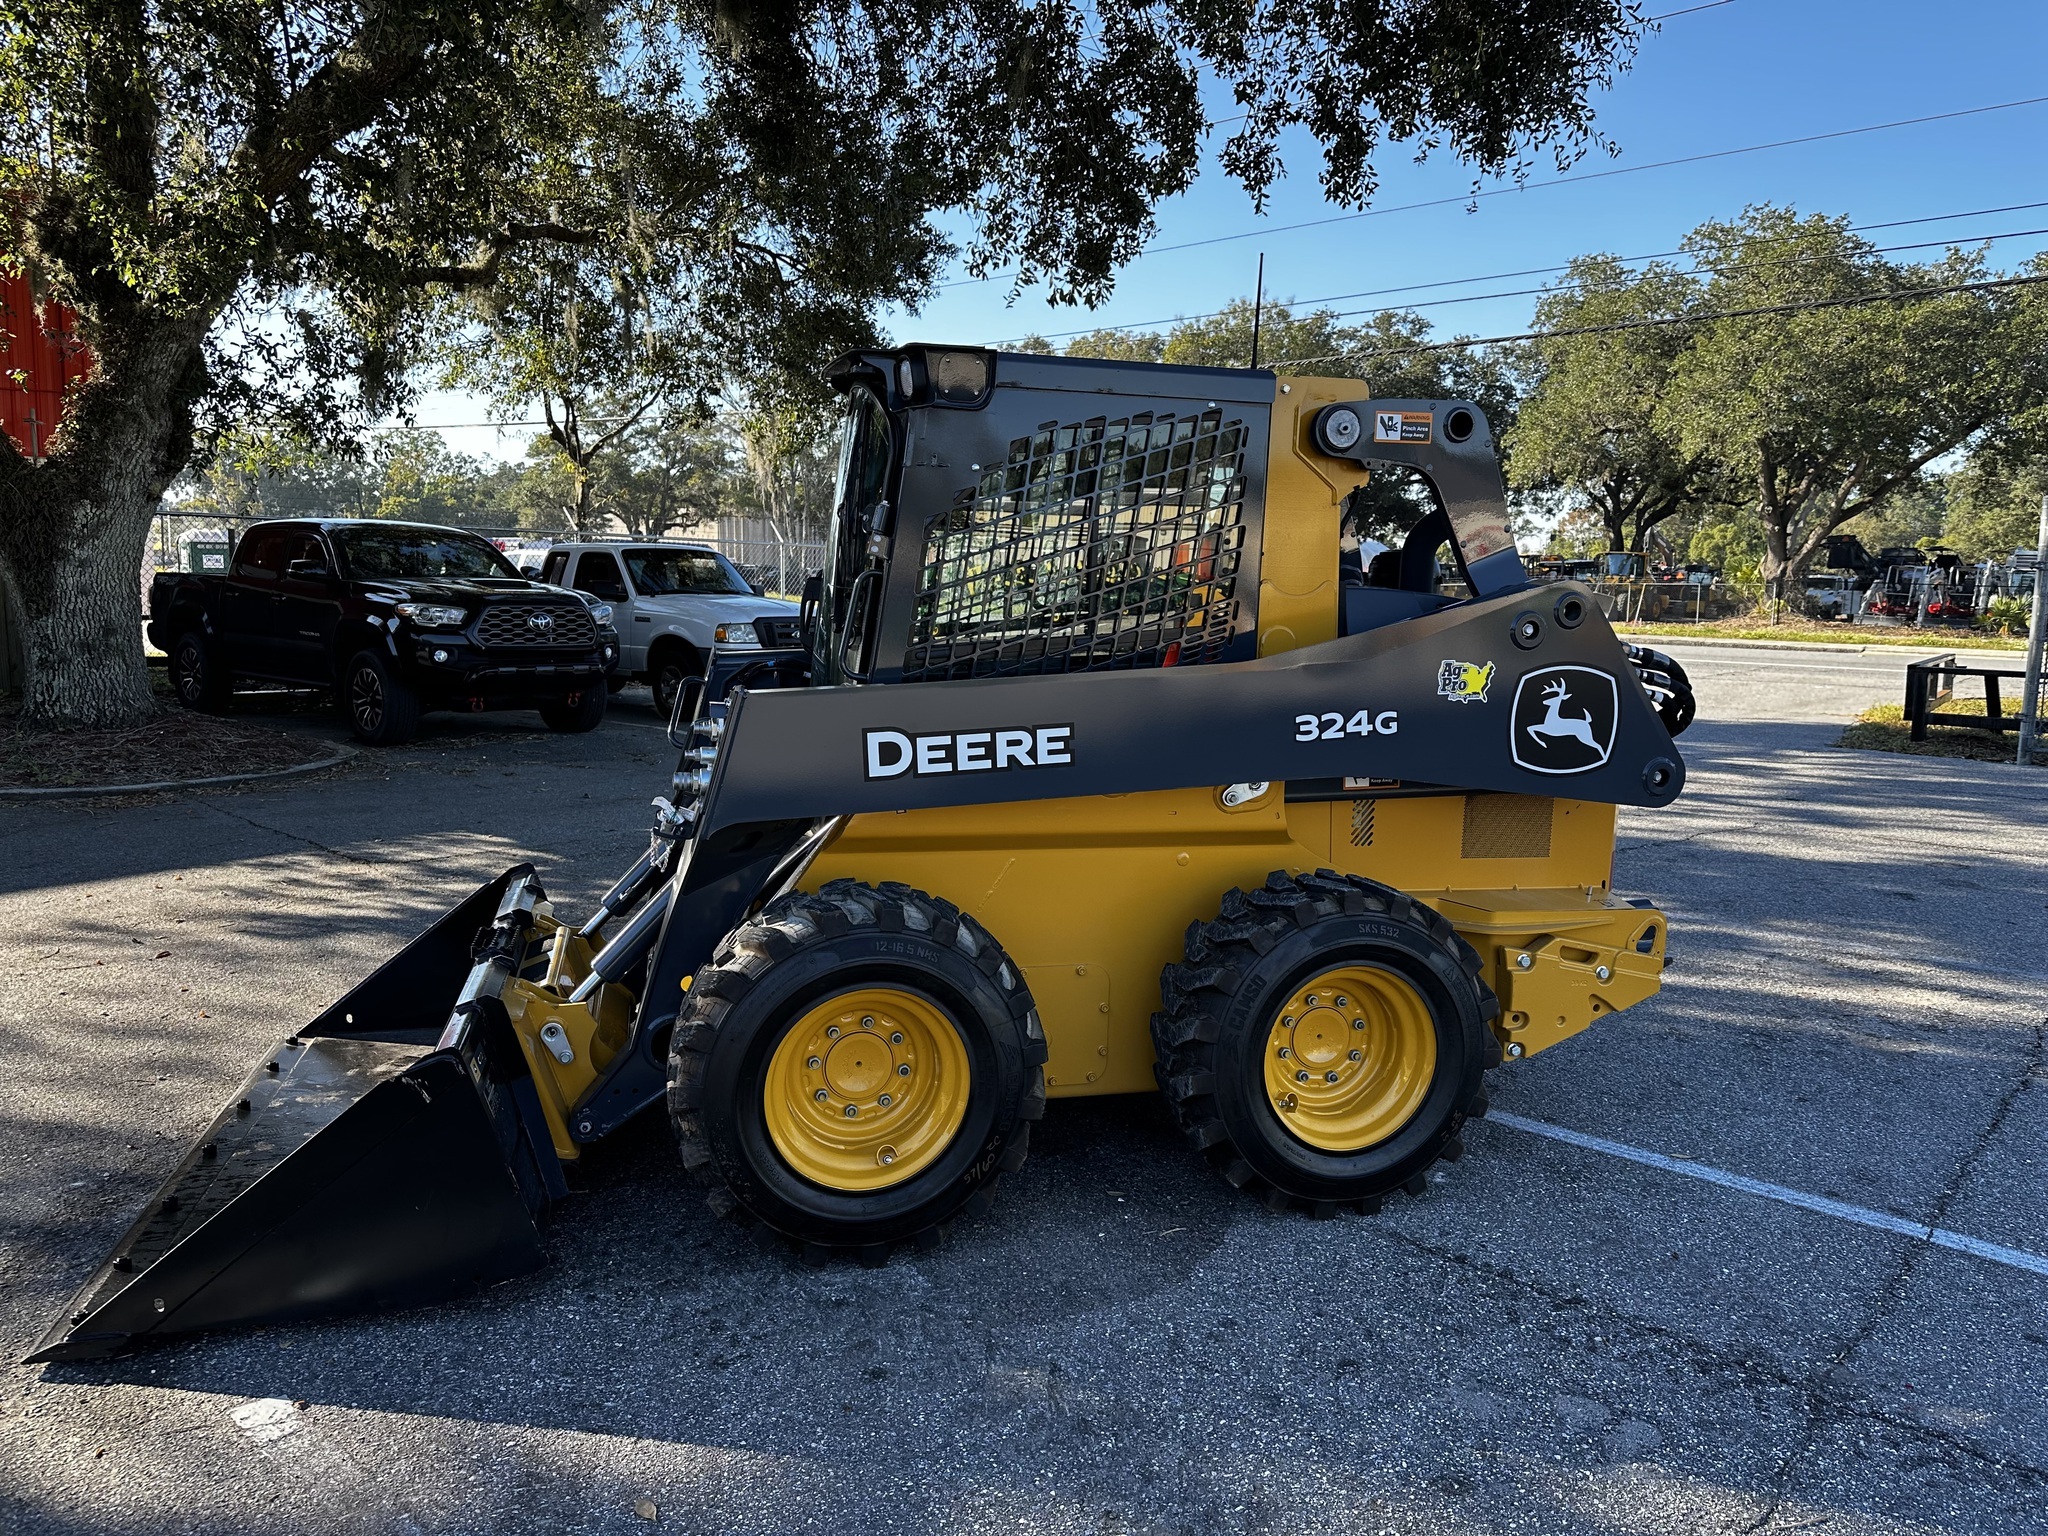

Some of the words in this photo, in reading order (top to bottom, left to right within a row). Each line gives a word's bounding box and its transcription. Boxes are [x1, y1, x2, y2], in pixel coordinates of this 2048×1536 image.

[1442, 662, 1468, 680] Ag-
[1441, 678, 1467, 692] Pro
[1295, 710, 1398, 742] 324G
[866, 726, 1071, 778] DEERE
[1358, 923, 1378, 934] SKS
[1380, 925, 1399, 938] 532
